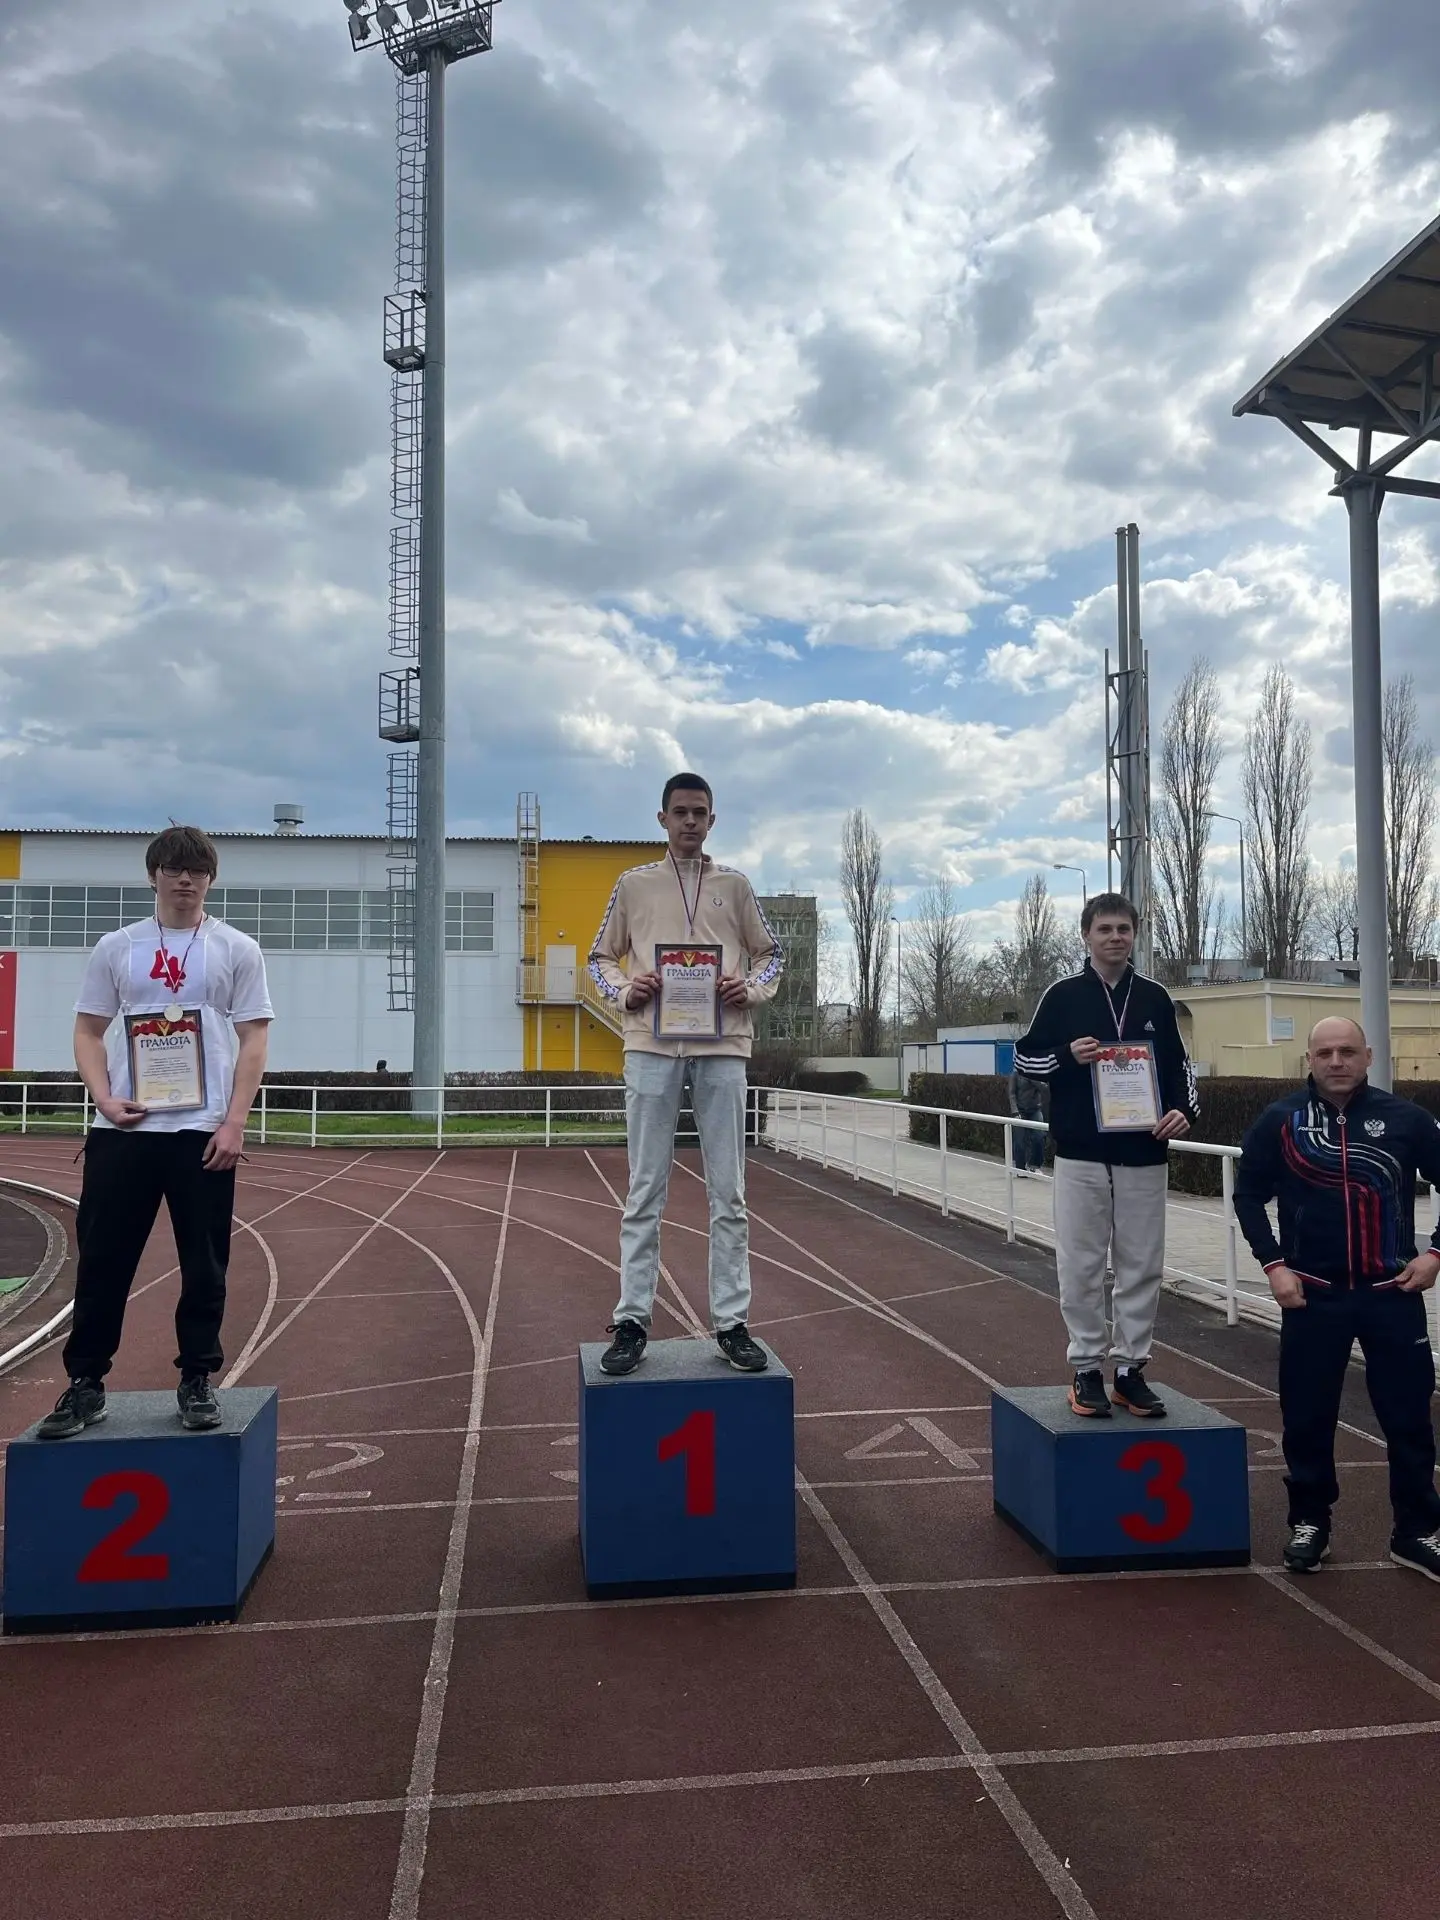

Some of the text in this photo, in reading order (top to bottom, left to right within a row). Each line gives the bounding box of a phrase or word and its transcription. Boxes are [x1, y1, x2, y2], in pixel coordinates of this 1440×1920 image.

[149, 948, 187, 993] 4
[666, 968, 711, 977] ГРАМОТА
[140, 1036, 191, 1048] ГРАМОТА
[657, 1410, 716, 1517] 1
[843, 1416, 993, 1470] 4
[1117, 1440, 1194, 1545] 3
[76, 1470, 171, 1584] 2
